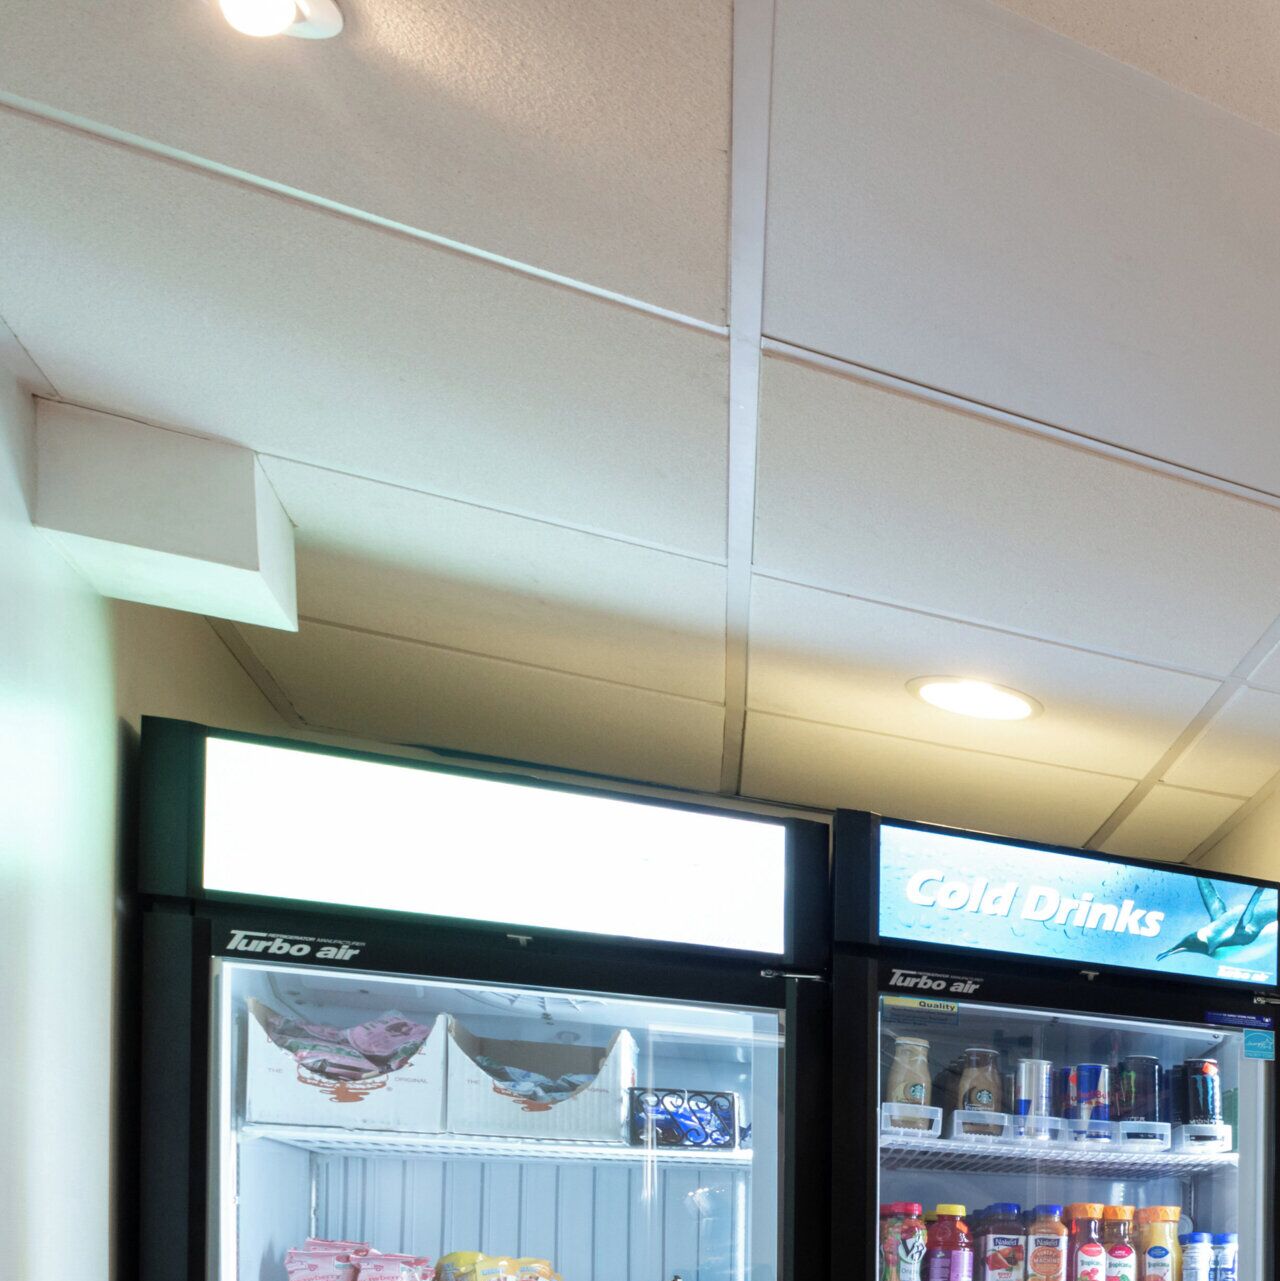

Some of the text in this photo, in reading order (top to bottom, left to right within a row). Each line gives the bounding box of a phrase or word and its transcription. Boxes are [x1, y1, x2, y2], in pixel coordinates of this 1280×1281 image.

[906, 869, 1164, 938] Cold Drinks
[226, 929, 360, 960] Turbo air
[267, 933, 366, 947] REFRIGERATOR MANUFACTURER
[889, 968, 984, 994] Turbo air
[918, 1000, 956, 1013] Quality
[394, 1077, 428, 1085] ORIGINAL
